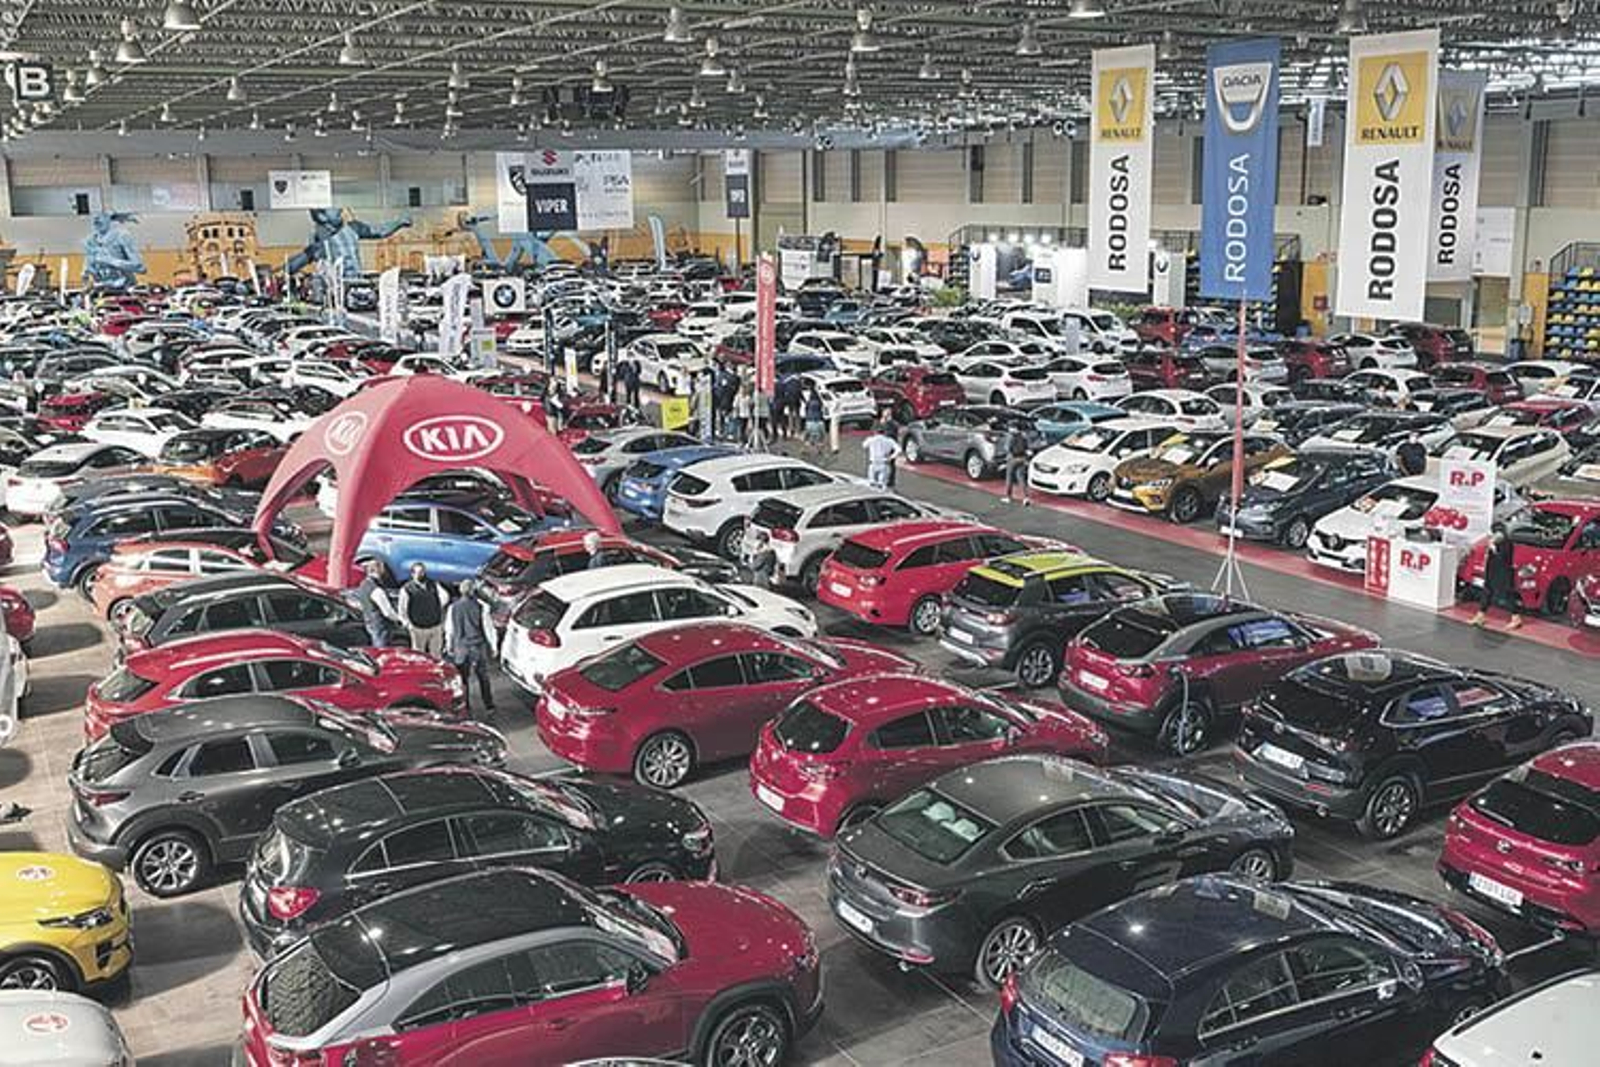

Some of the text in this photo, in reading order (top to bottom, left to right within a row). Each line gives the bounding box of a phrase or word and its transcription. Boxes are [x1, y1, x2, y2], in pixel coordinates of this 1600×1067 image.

[20, 68, 49, 96] B
[1222, 75, 1262, 88] DACIA
[1100, 127, 1141, 139] RENAULT
[1361, 126, 1419, 140] RENAULT
[535, 199, 569, 213] VIPER
[1108, 154, 1130, 271] RODOSA
[1224, 153, 1250, 282] RODOSA
[1437, 164, 1461, 264] RODOSA
[1368, 159, 1400, 301] RODOSA
[419, 424, 490, 452] KIA
